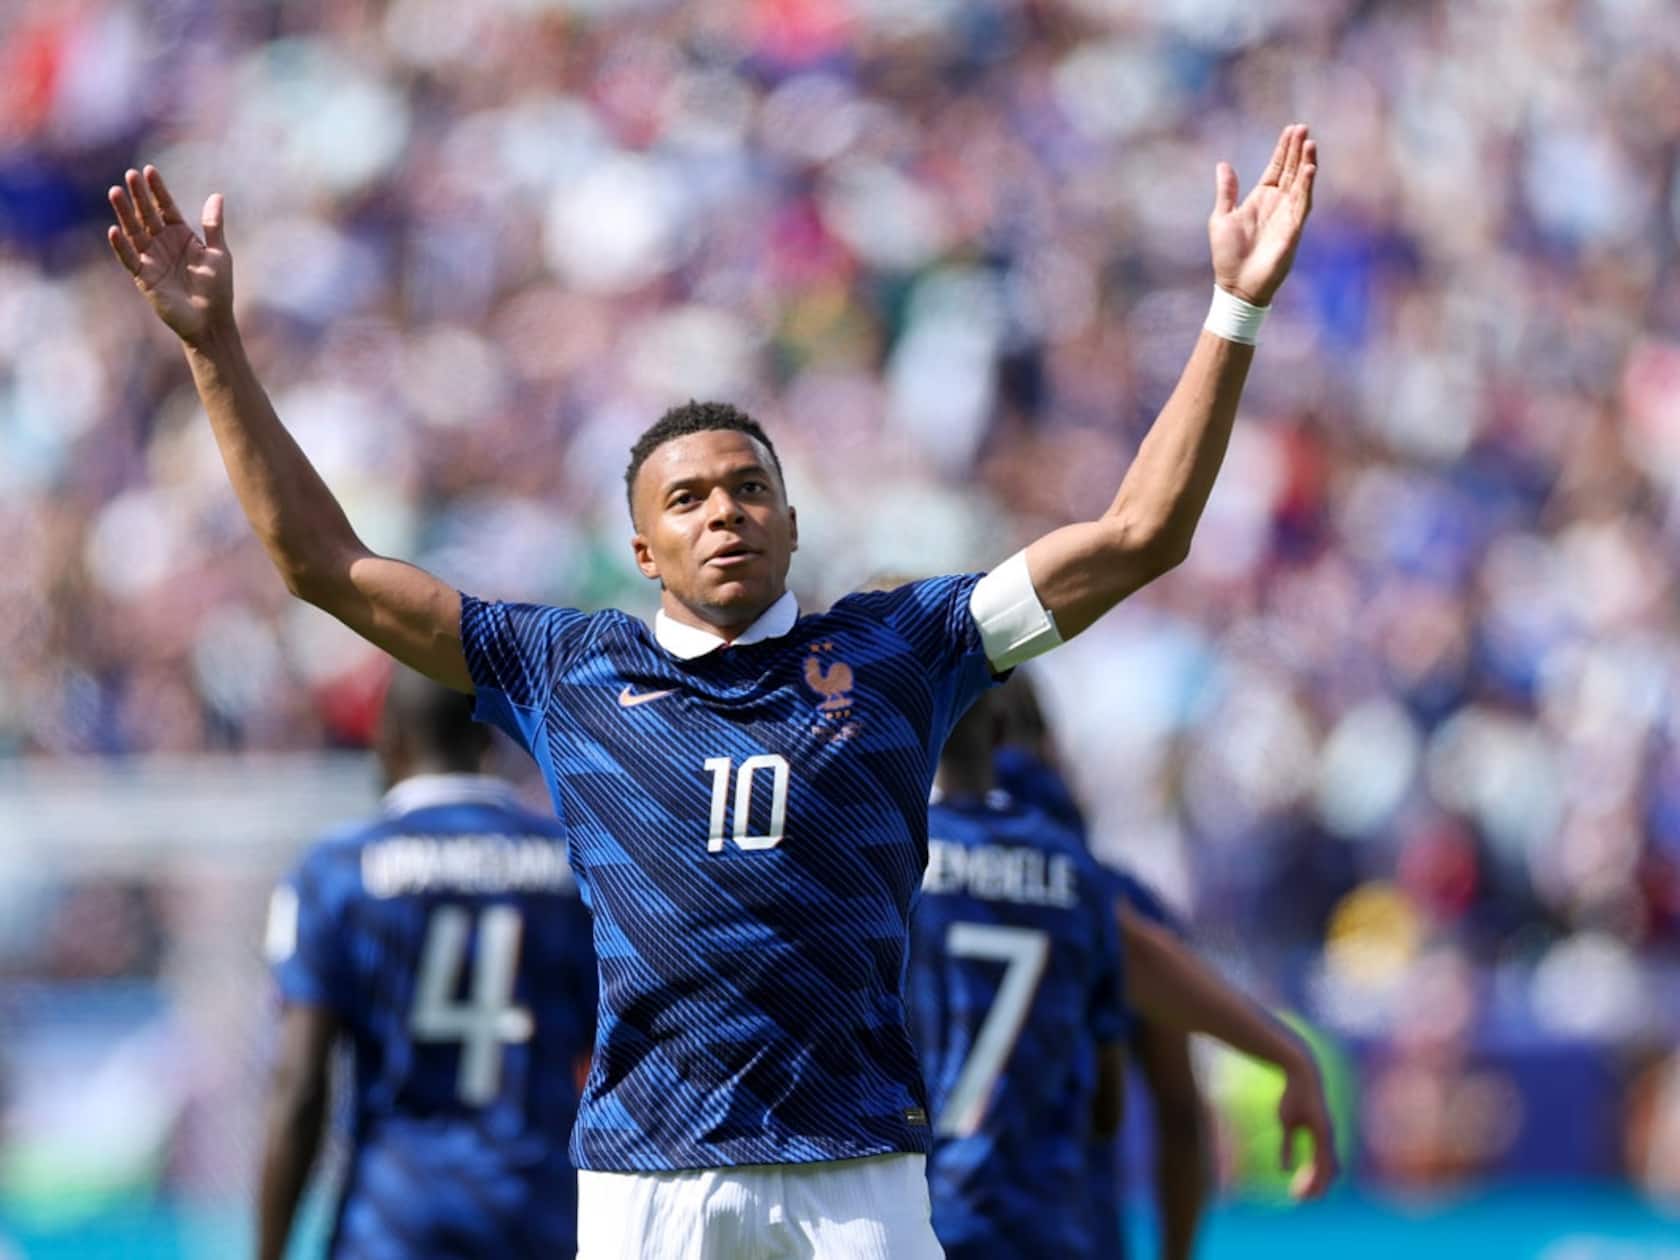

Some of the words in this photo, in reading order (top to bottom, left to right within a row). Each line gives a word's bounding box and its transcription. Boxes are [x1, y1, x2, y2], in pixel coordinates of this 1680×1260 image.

[704, 753, 790, 853] 10
[410, 905, 534, 1106] 4
[940, 922, 1050, 1136] 7
